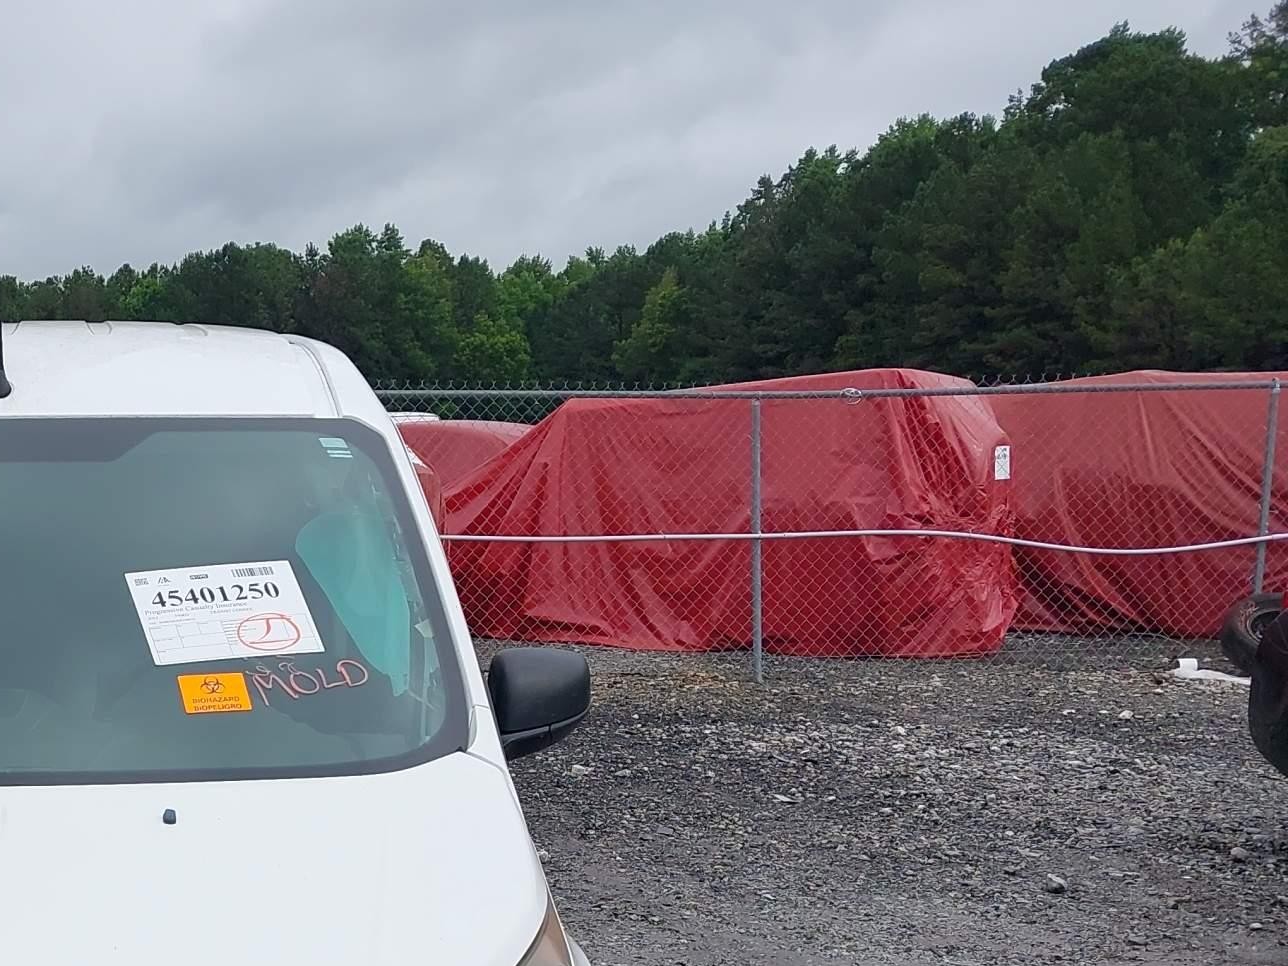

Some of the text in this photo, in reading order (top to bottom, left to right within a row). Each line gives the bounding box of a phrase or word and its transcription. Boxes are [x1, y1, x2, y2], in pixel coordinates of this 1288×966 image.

[152, 581, 279, 608] 45401250
[185, 603, 214, 612] Casualty
[215, 601, 248, 609] Insurance
[252, 659, 368, 706] MOLD
[192, 696, 240, 704] BIOHAZARD
[193, 703, 242, 711] BIOPELIGRO
